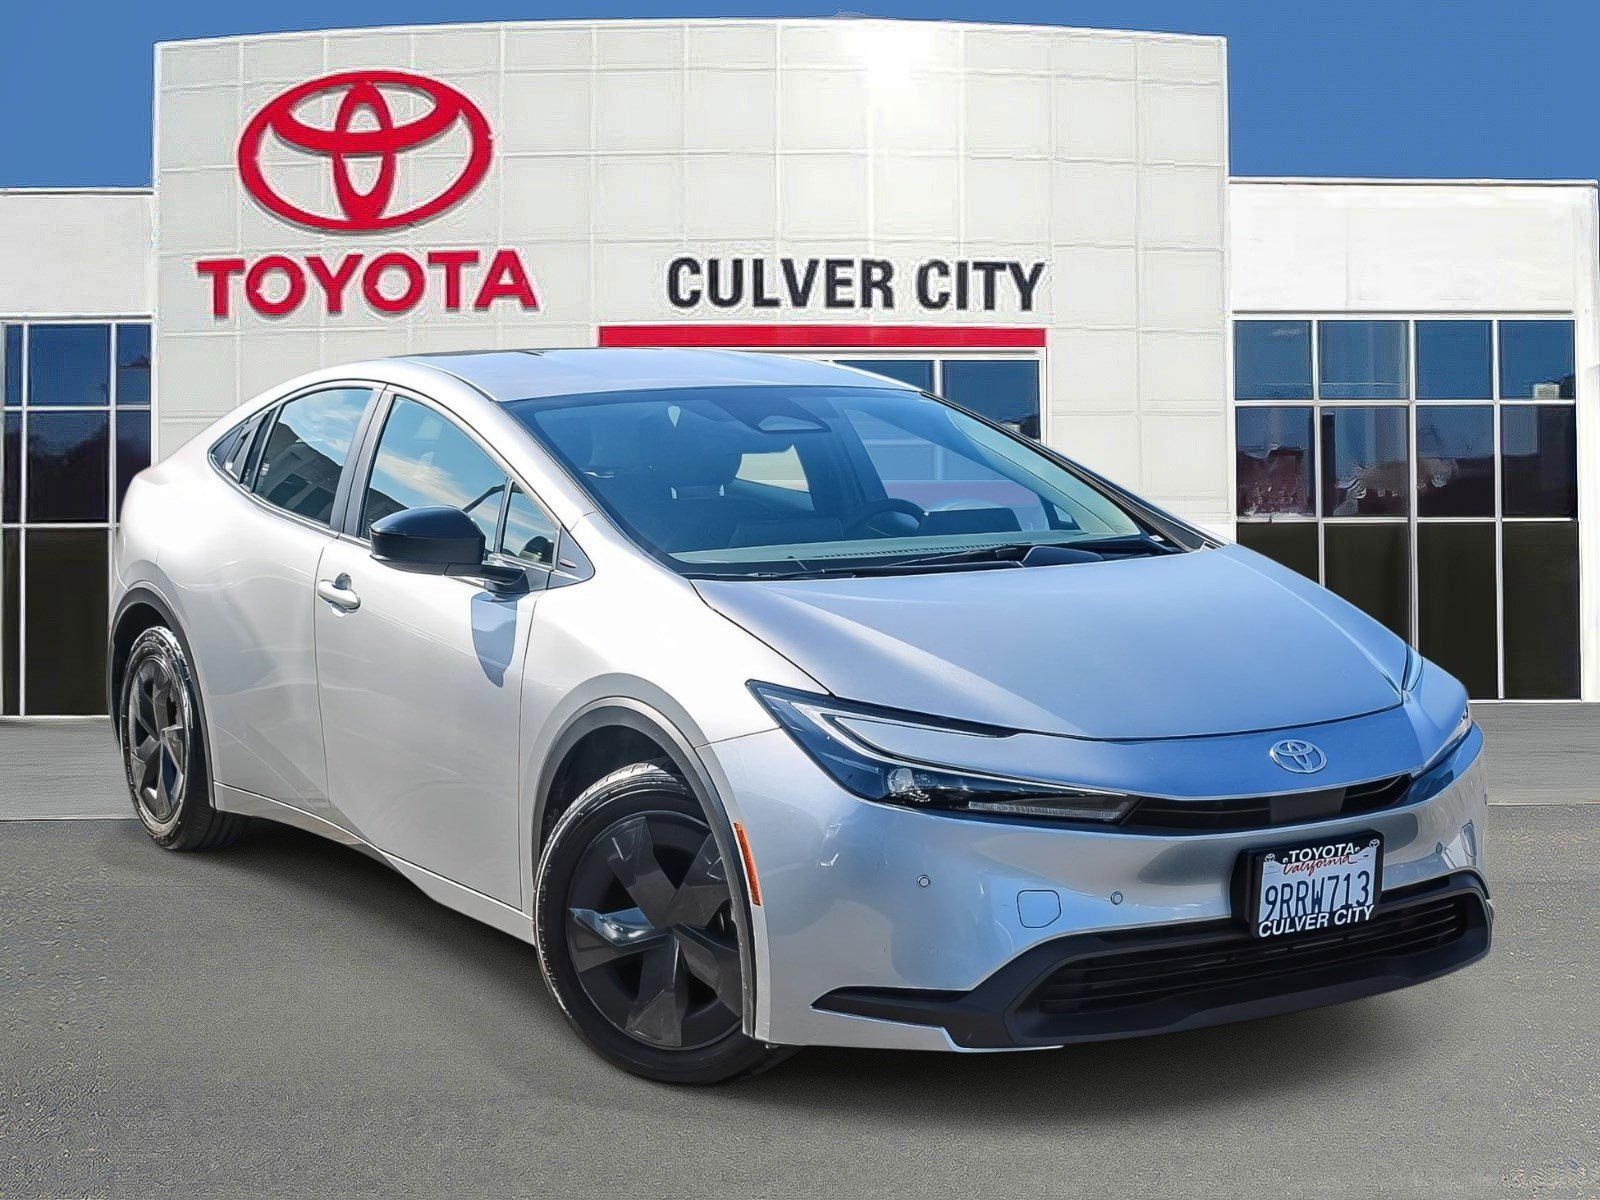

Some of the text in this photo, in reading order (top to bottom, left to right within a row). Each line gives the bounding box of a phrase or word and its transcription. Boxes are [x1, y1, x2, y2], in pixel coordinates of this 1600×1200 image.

[197, 249, 539, 318] TOYOTA
[668, 257, 1046, 311] CULVER CITY
[1283, 855, 1357, 876] California
[1289, 843, 1355, 863] TOYOTA
[1264, 870, 1370, 923] 9RRW713
[1258, 904, 1375, 937] CULVER CITY
